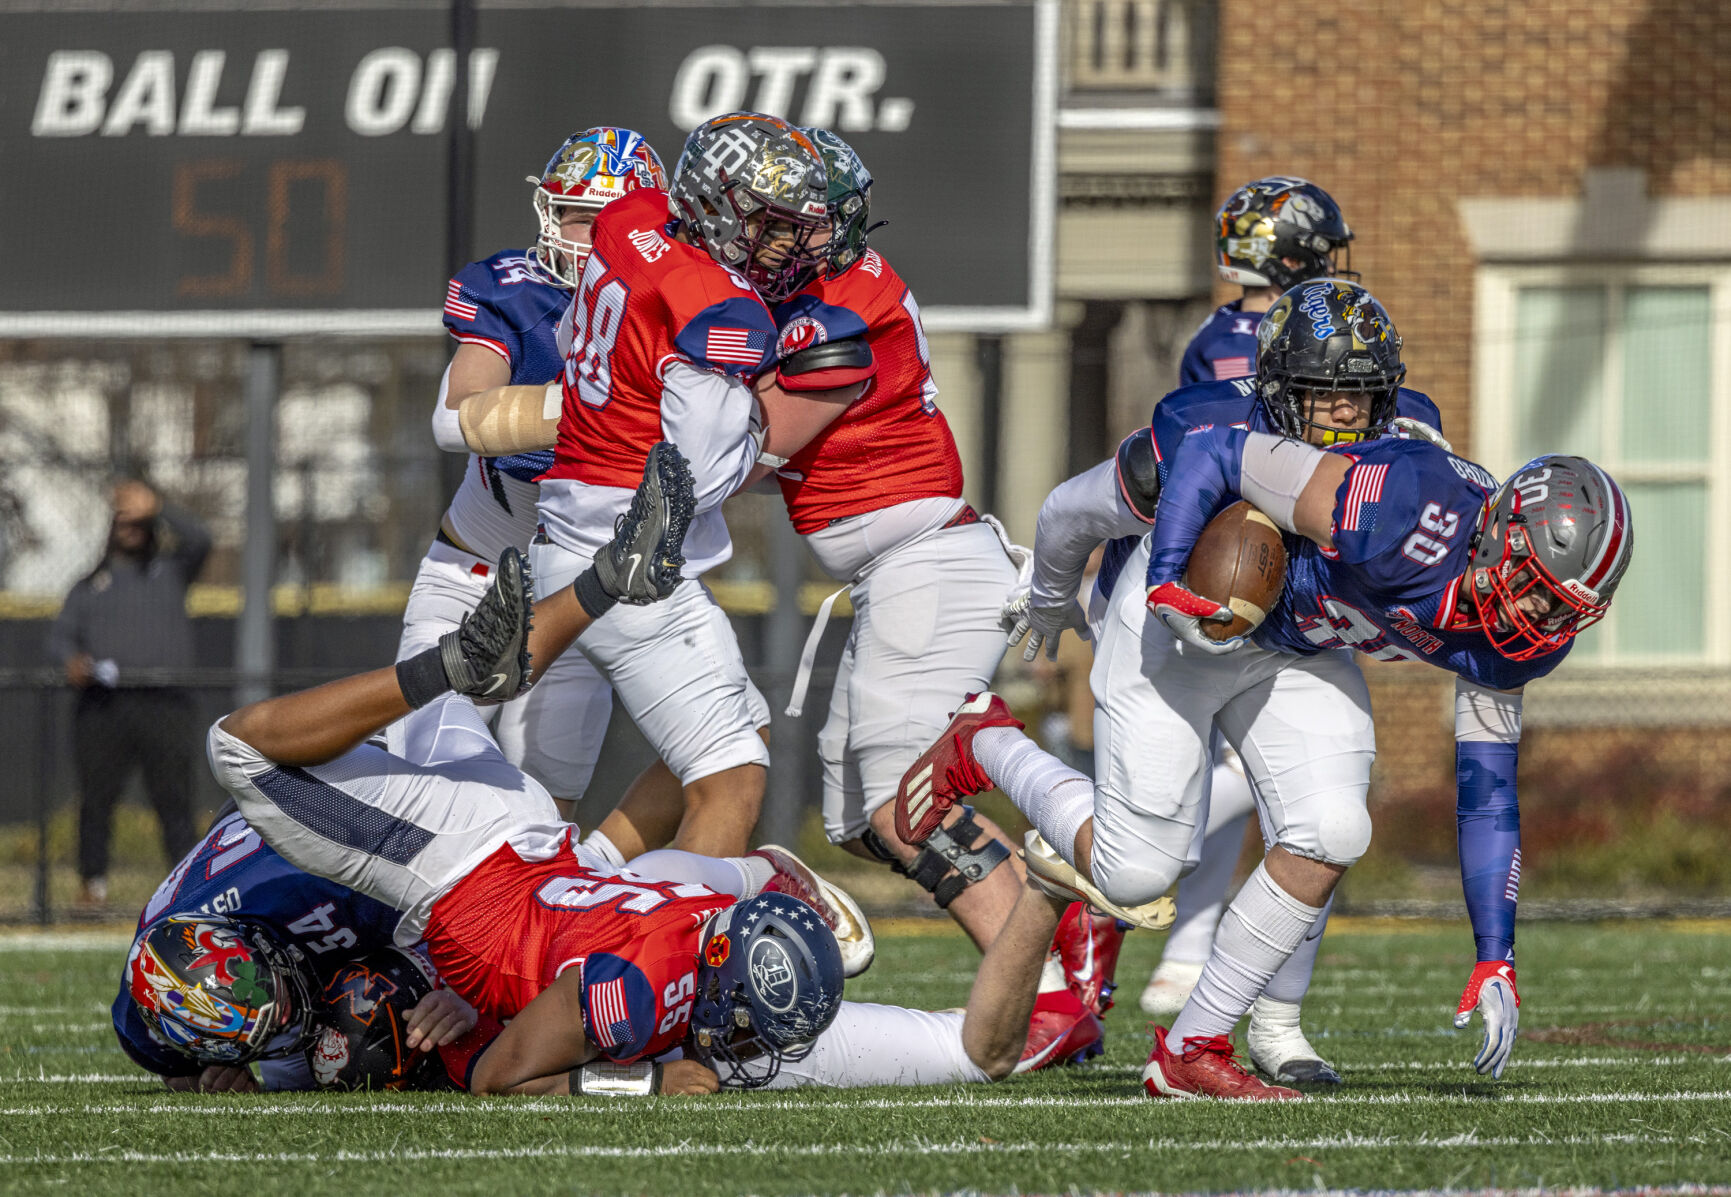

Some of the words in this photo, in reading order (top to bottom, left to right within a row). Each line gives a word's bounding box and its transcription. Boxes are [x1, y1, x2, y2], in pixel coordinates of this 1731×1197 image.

[31, 49, 305, 137] BALL
[172, 158, 348, 297] 50
[627, 229, 671, 263] JONES
[492, 256, 552, 286] 44
[1299, 282, 1336, 341] Tigers
[1257, 542, 1270, 577] GST
[1401, 500, 1460, 567] 30
[1569, 583, 1599, 604] Riddell
[1391, 620, 1445, 656] NORTH
[286, 901, 360, 955] 54
[657, 969, 696, 1036] 55
